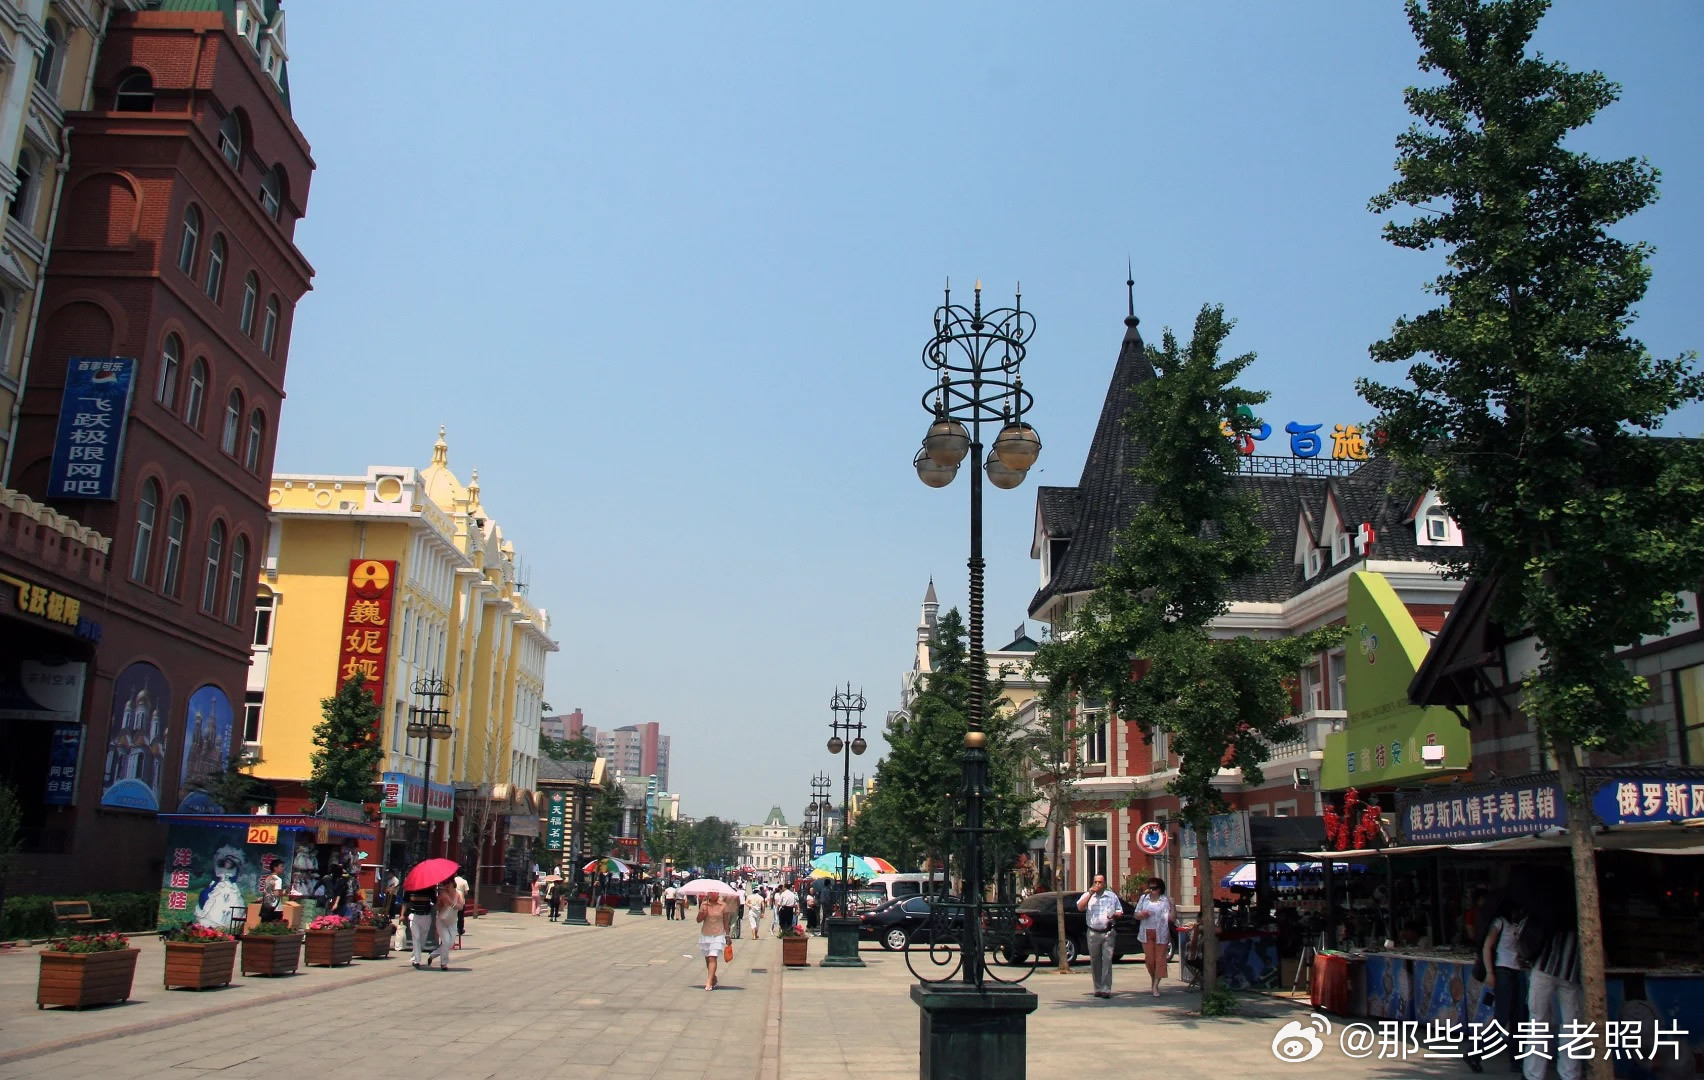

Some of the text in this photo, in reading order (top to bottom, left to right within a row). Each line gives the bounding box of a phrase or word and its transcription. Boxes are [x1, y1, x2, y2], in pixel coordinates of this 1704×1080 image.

[78, 361, 124, 372] 百事可乐
[63, 397, 113, 495] 飞跃极限网吧
[1284, 421, 1388, 460] 百施
[47, 780, 73, 792] 台球
[49, 766, 75, 778] 网吧
[549, 805, 562, 849] 天福茗茶
[1410, 787, 1556, 831] 俄罗斯风情手表展销
[168, 847, 192, 910] 洋娃娃
